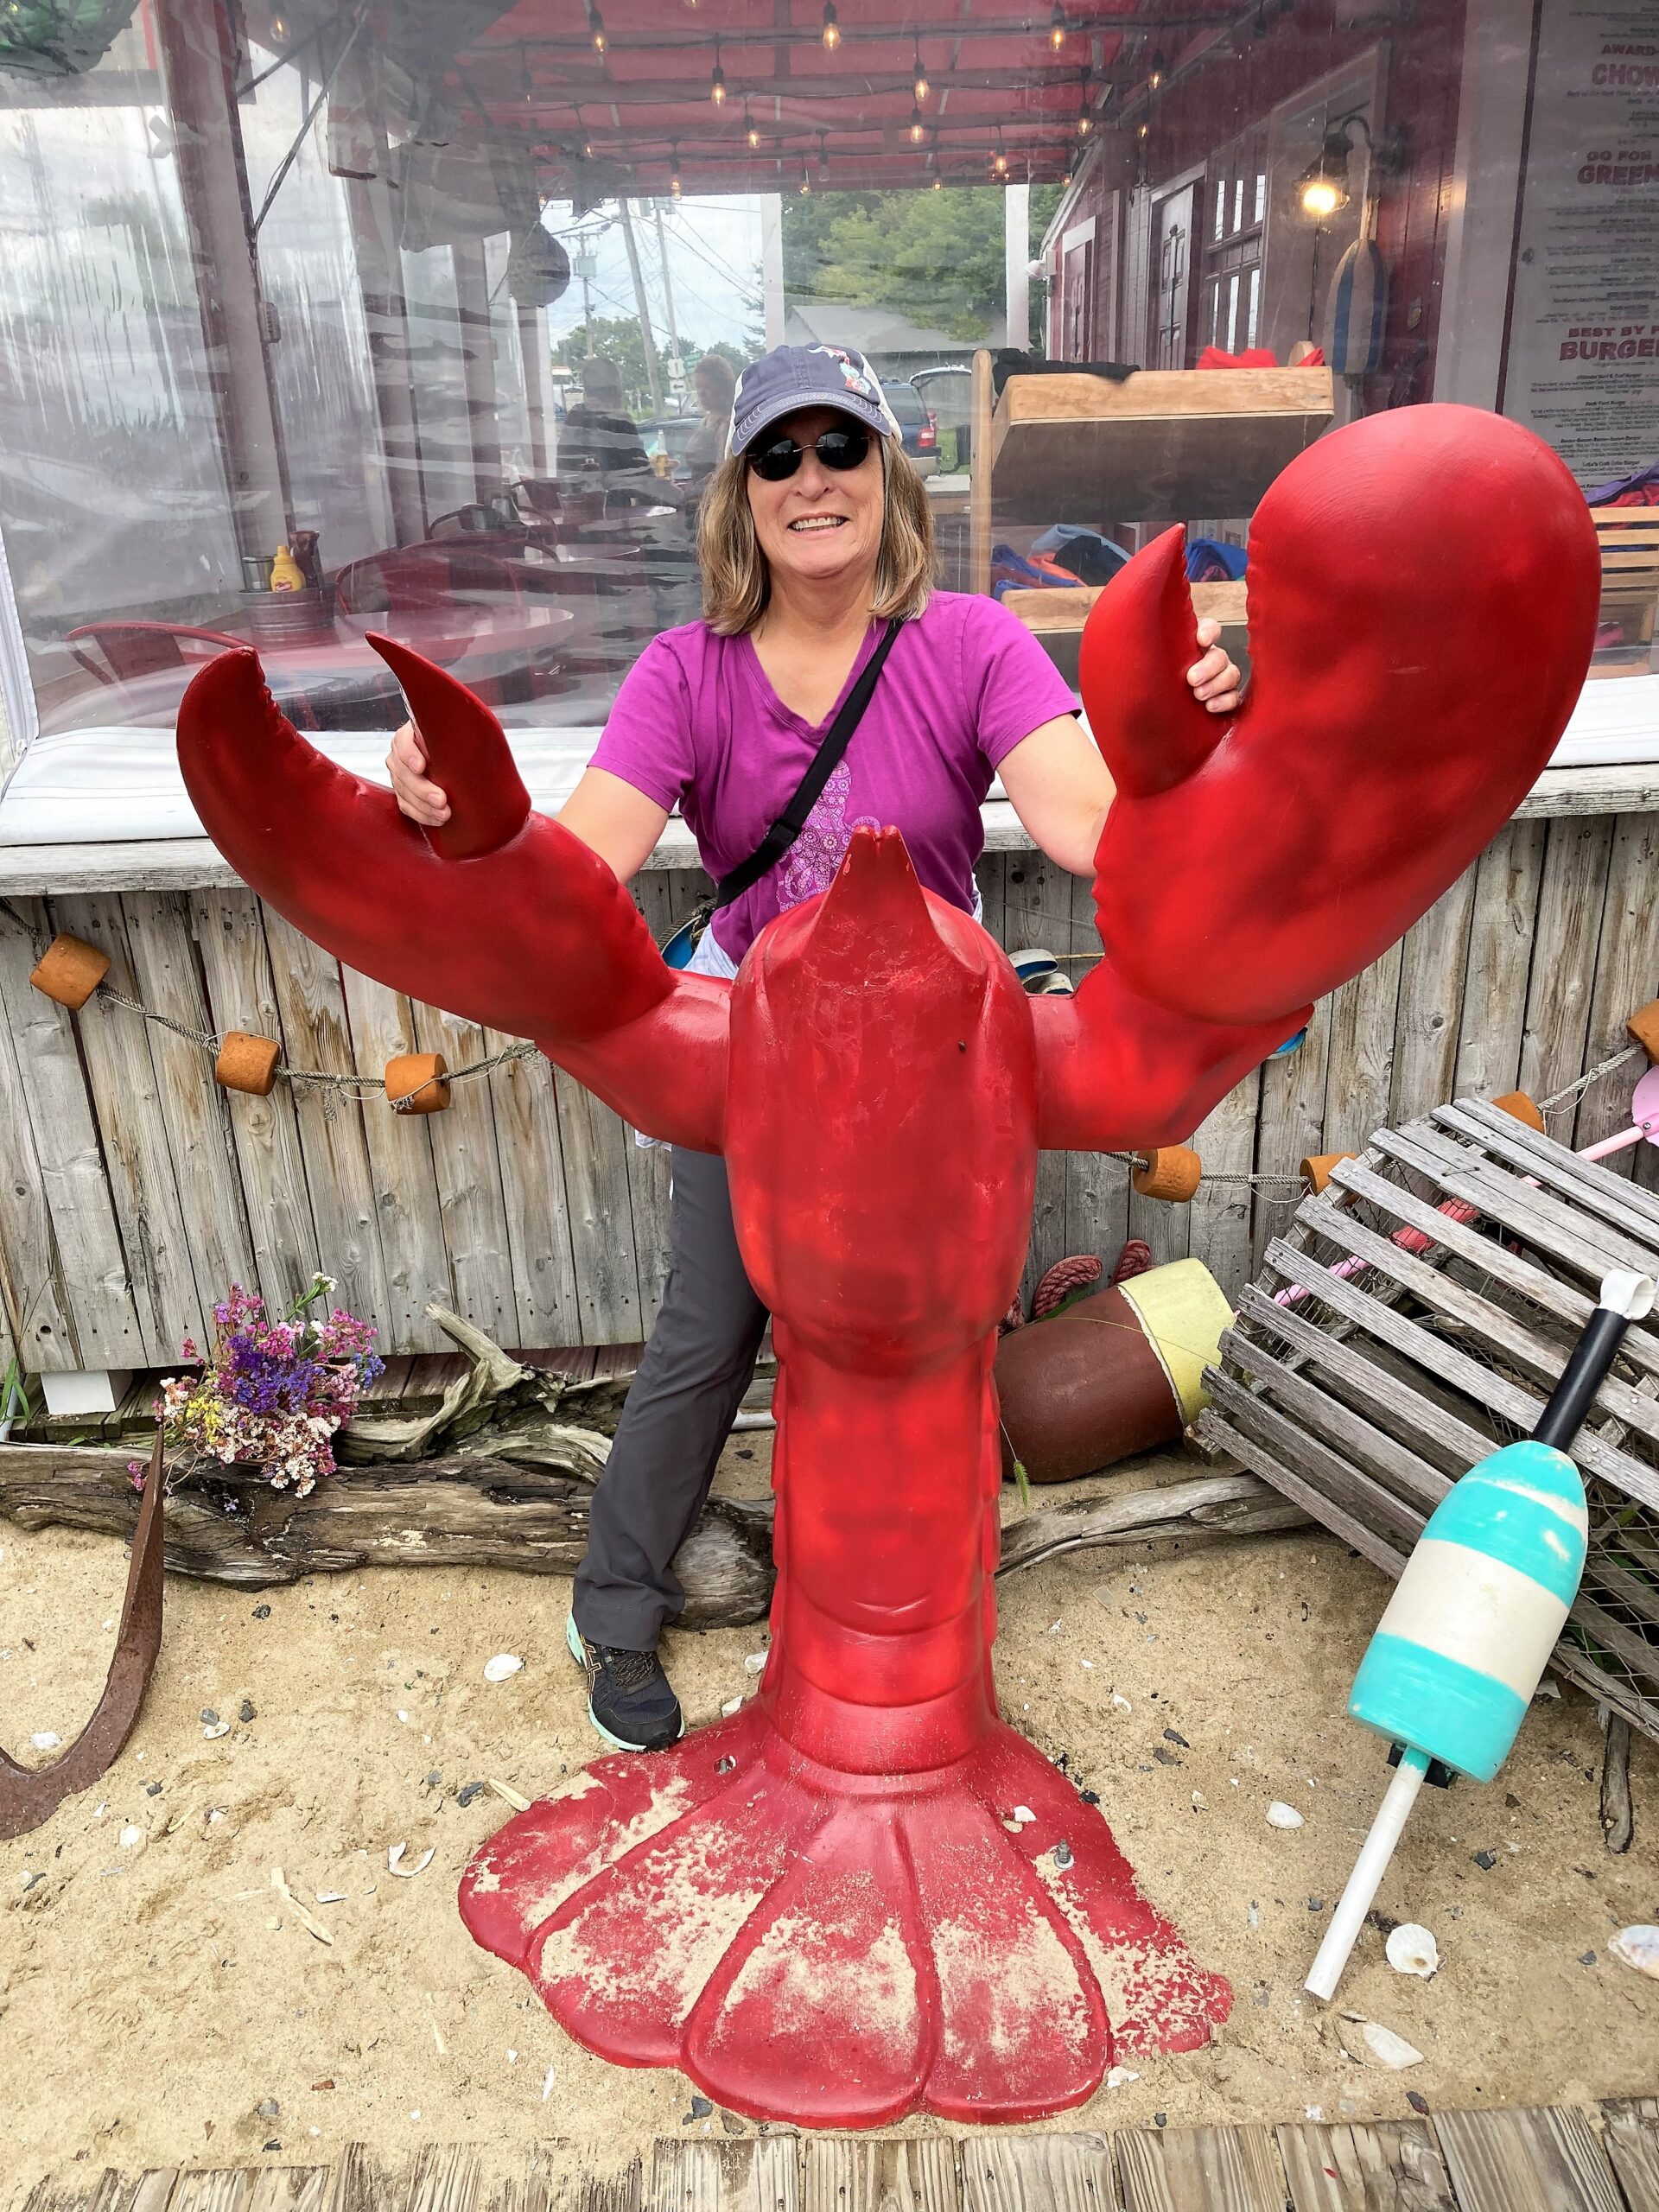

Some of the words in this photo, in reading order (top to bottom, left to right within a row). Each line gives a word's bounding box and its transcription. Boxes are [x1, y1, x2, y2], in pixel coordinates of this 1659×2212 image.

[1586, 150, 1612, 162] GO
[1618, 149, 1652, 162] FOR
[1568, 327, 1615, 338] BEST
[1620, 326, 1645, 336] BY
